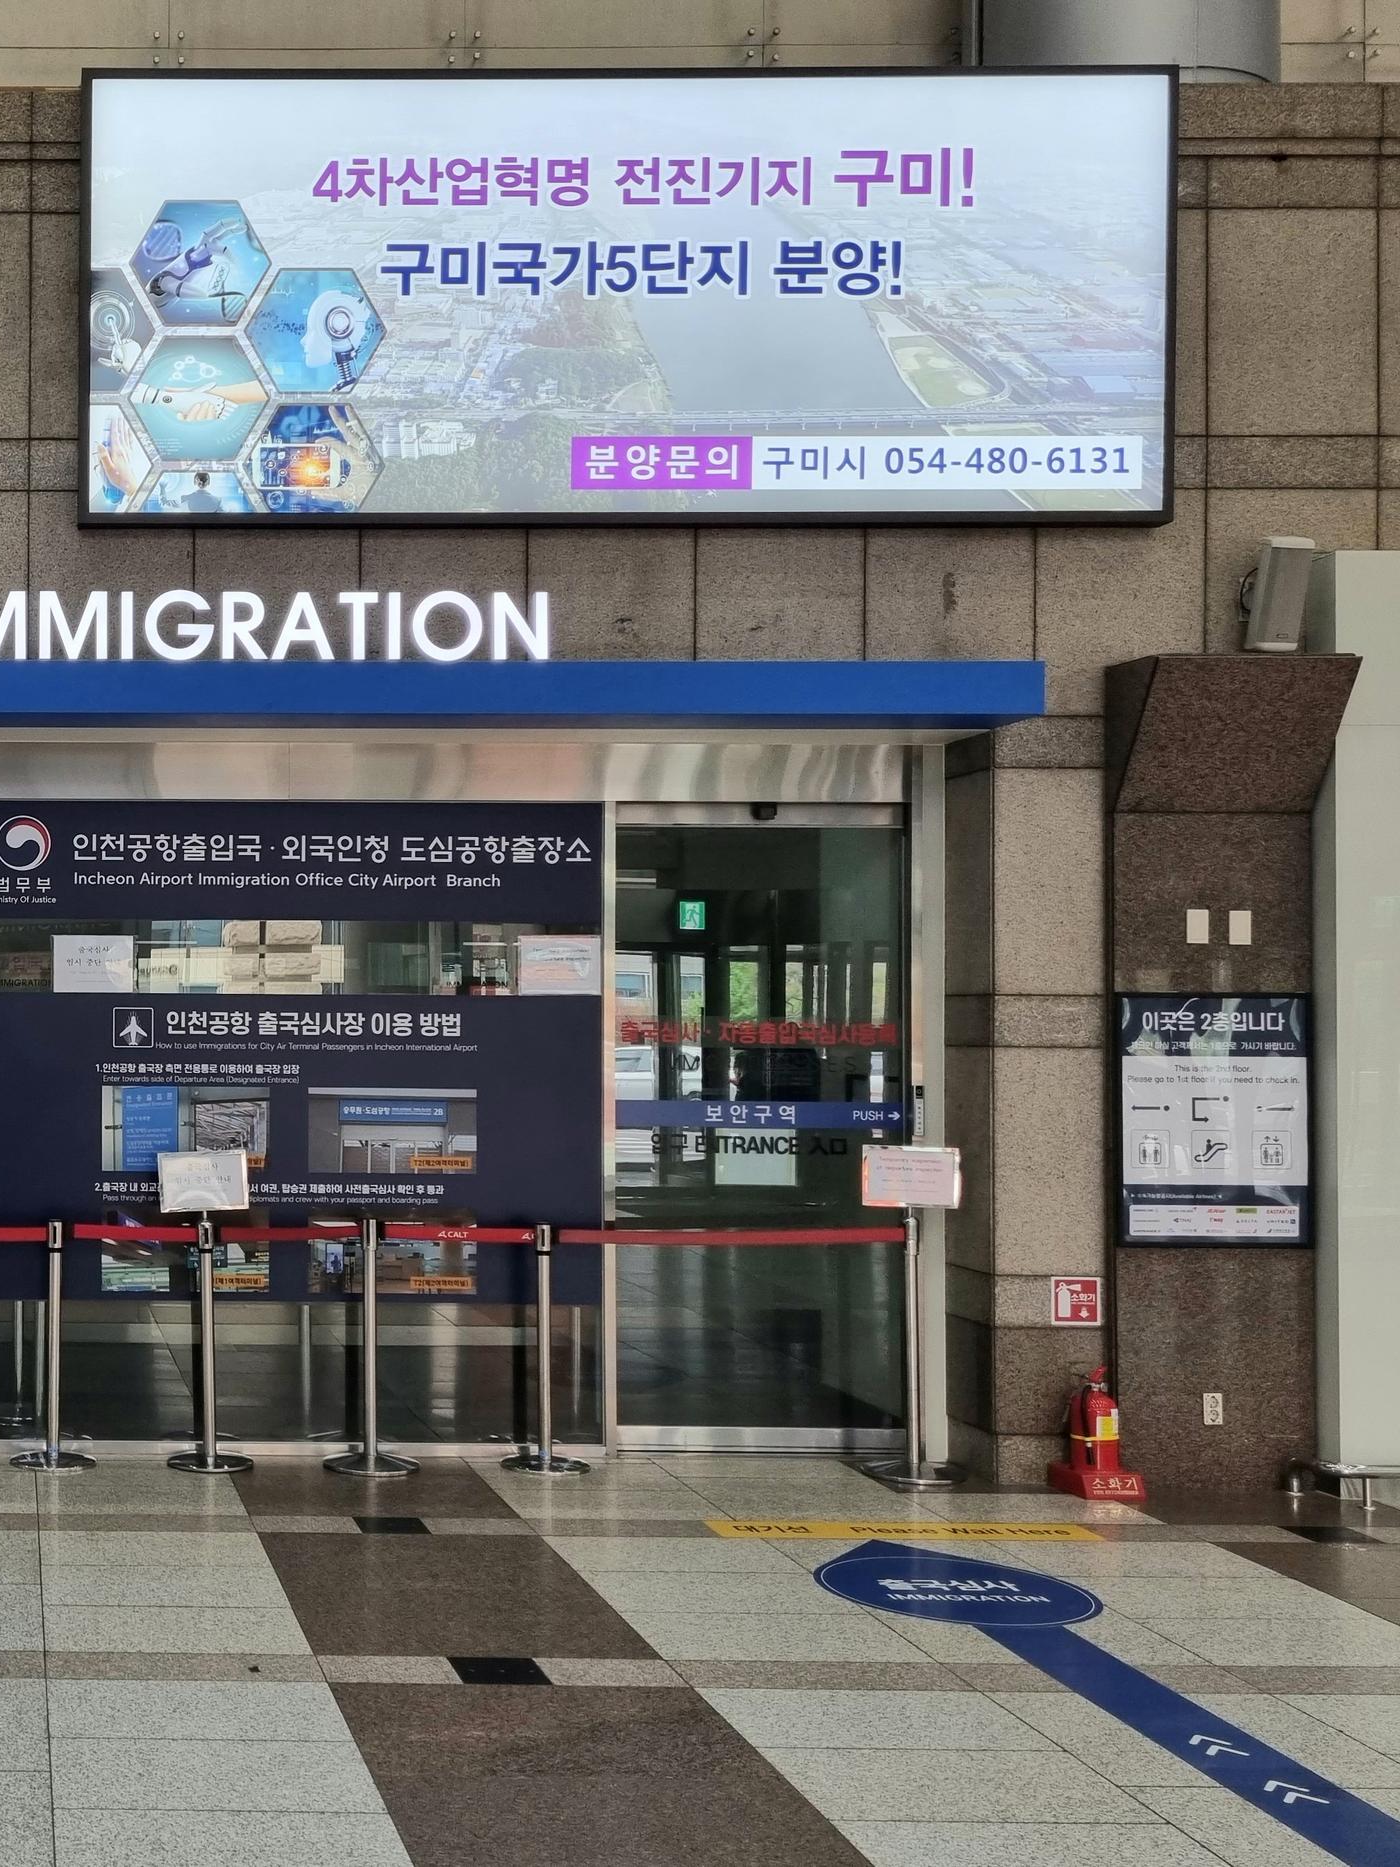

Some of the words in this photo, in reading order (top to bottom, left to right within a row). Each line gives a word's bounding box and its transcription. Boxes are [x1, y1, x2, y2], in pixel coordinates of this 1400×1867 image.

[313, 155, 591, 207] 4차산업혁명
[614, 155, 811, 206] 전진기지
[833, 145, 975, 208] 구미!
[380, 239, 749, 297] 구미국가5단지
[774, 239, 903, 297] 분양!
[584, 443, 739, 481] 분양문의
[762, 445, 867, 481] 구미시
[884, 446, 1131, 475] 054-480-6131
[401, 836, 592, 865] 도심공항출장소
[73, 872, 137, 887] Incheon
[140, 873, 193, 890] Airport
[198, 873, 292, 890] Immigration
[295, 873, 344, 888] Office
[348, 873, 380, 891] City
[383, 873, 437, 891] Airport
[446, 873, 501, 888] Branch
[31, 895, 57, 904] Justice
[166, 1011, 252, 1035] 인천공항
[257, 1012, 365, 1036] 출국심사장
[371, 1012, 413, 1036] 이용
[420, 1013, 461, 1037] 방법
[1142, 1011, 1196, 1032] 이곳은
[1200, 1012, 1286, 1032] 2층입니다
[155, 1042, 172, 1050] How
[174, 1042, 182, 1050] to
[199, 1042, 246, 1051] Immigrations
[248, 1042, 258, 1050] for
[260, 1042, 275, 1051] City
[277, 1042, 286, 1050] Air
[288, 1042, 320, 1050] Terminal
[321, 1043, 365, 1052] Passengers
[366, 1043, 373, 1051] in
[374, 1043, 404, 1051] Incheon
[405, 1043, 451, 1051] International
[453, 1043, 478, 1052] Airport
[704, 1104, 796, 1125] 보안구역
[852, 1110, 884, 1121] PUSH
[695, 1134, 800, 1155] ENTRANCE
[1071, 1292, 1096, 1302] 소화기
[1091, 1477, 1138, 1491] 소화기
[850, 1526, 945, 1536] Please
[947, 1527, 1004, 1536] Wait
[1004, 1527, 1072, 1536] Here
[877, 1578, 1021, 1592] 출국심사
[886, 1592, 1051, 1604] IMMIGRATION
